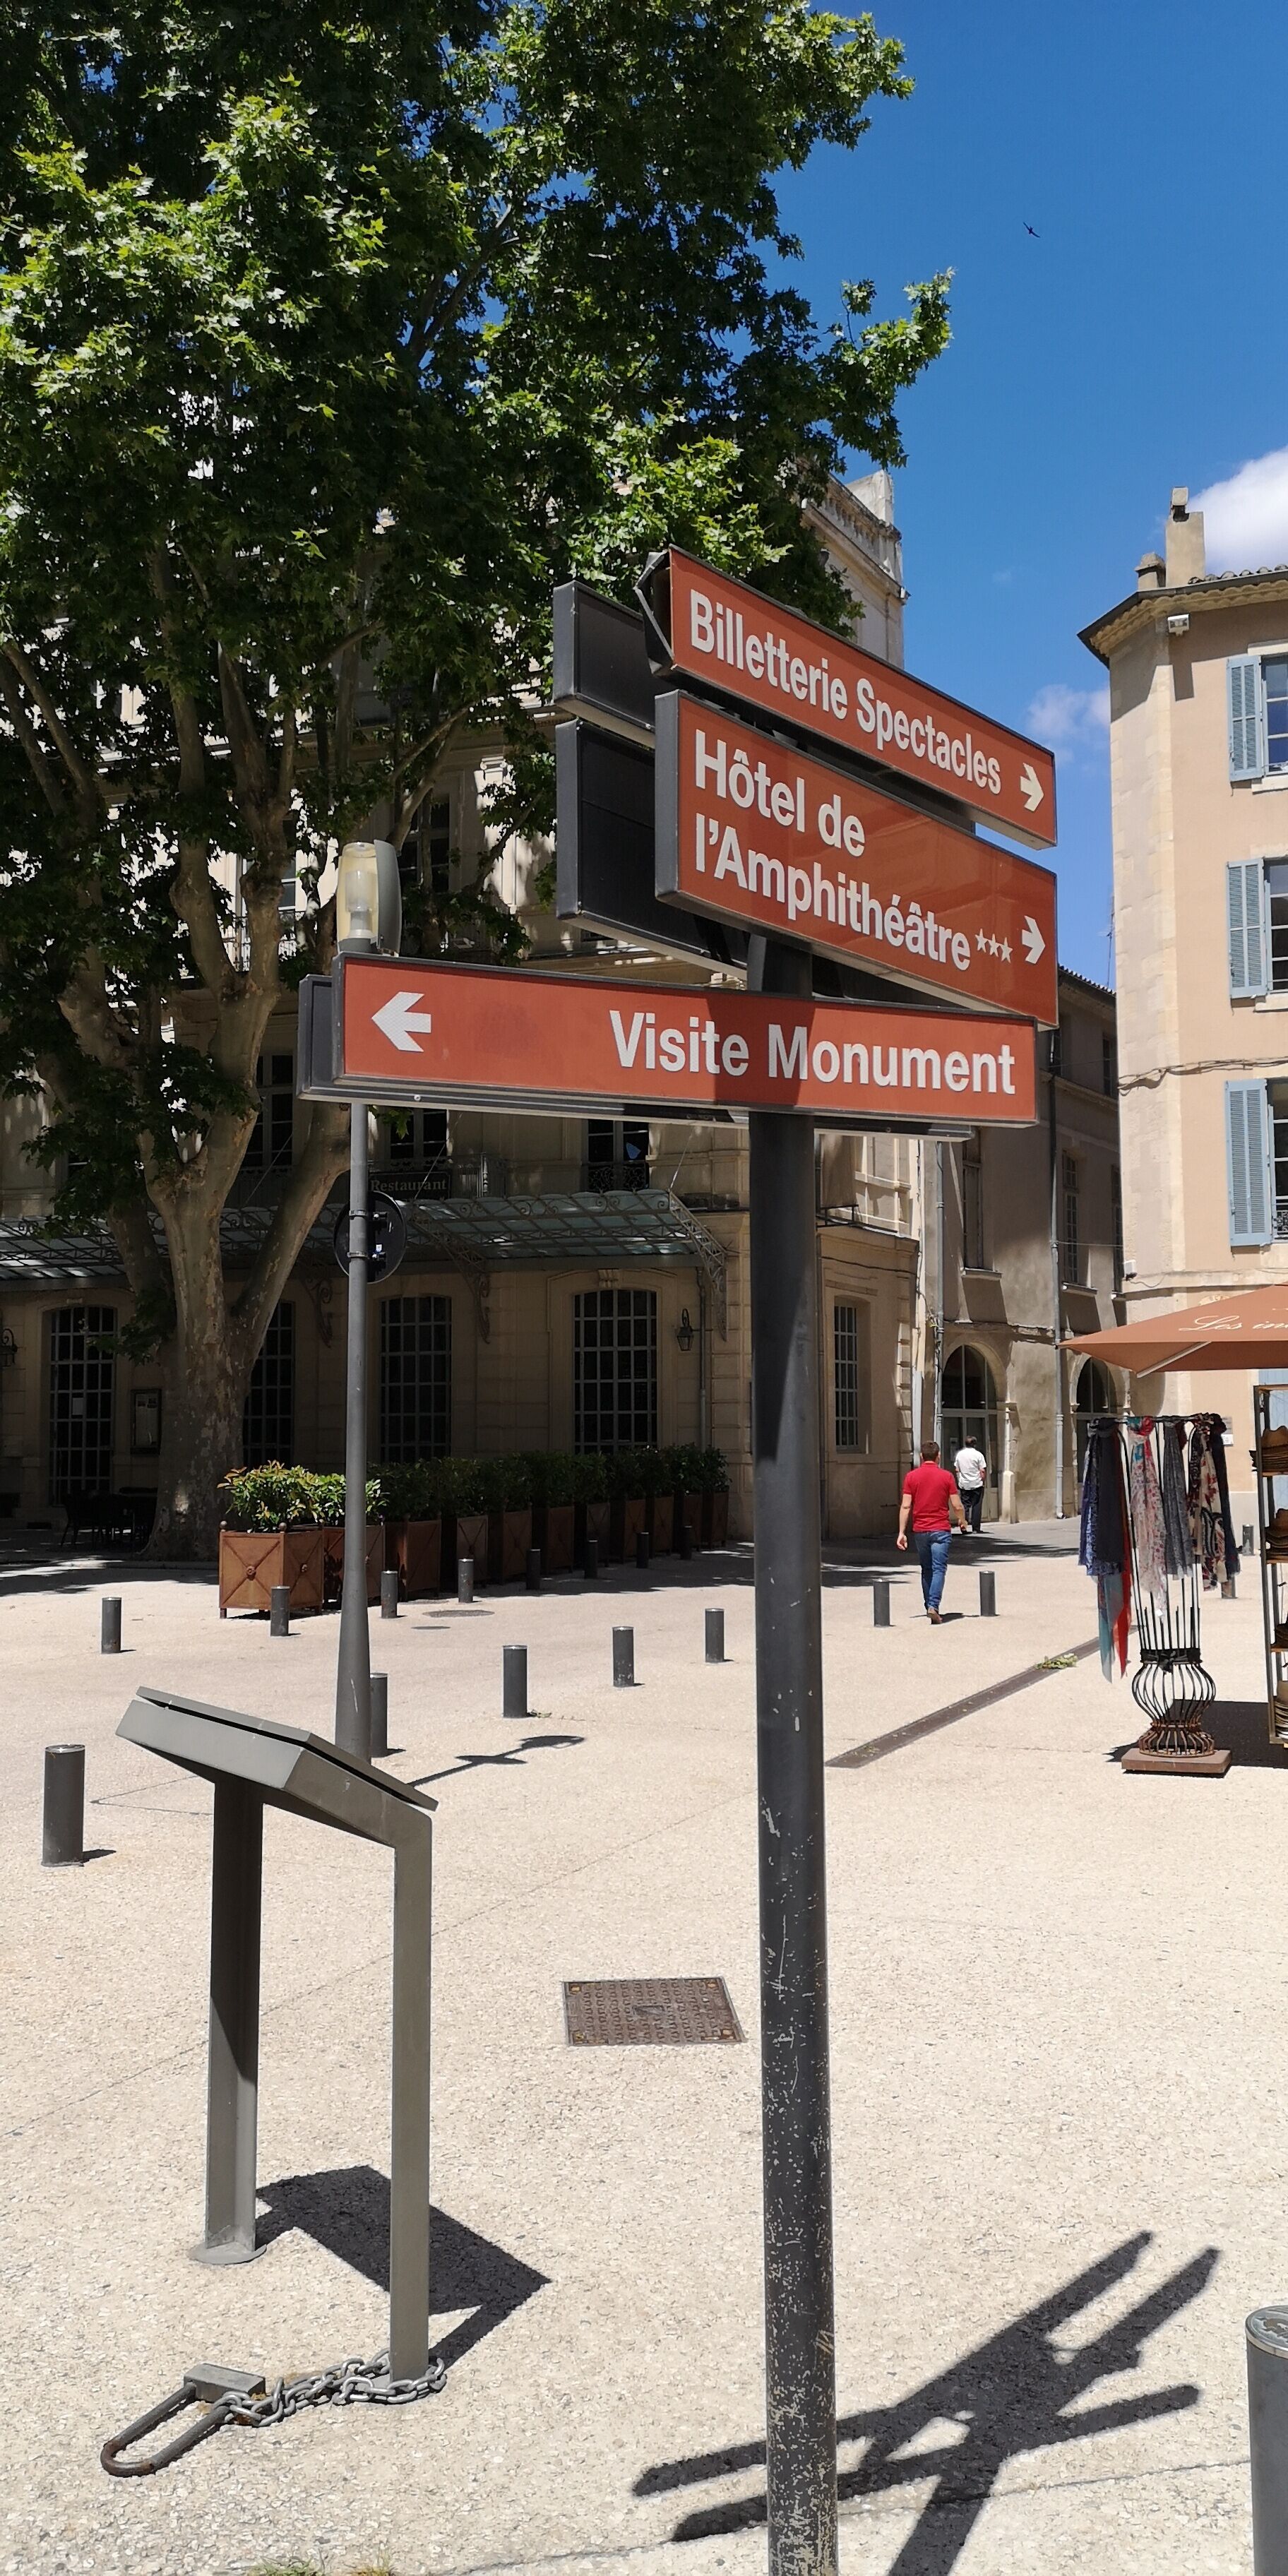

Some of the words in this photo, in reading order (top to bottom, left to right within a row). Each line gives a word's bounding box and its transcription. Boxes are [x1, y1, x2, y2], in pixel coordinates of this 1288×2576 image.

[689, 588, 848, 720] Billetterie
[856, 677, 1002, 795] Spectacles
[695, 728, 806, 833] Hôtel
[817, 793, 866, 857] de
[695, 812, 972, 972] l'Amphithéâtre
[608, 1009, 749, 1076] Visite
[768, 1023, 1016, 1095] Monument
[370, 1179, 447, 1192] Restaurant
[1179, 1315, 1243, 1331] Les
